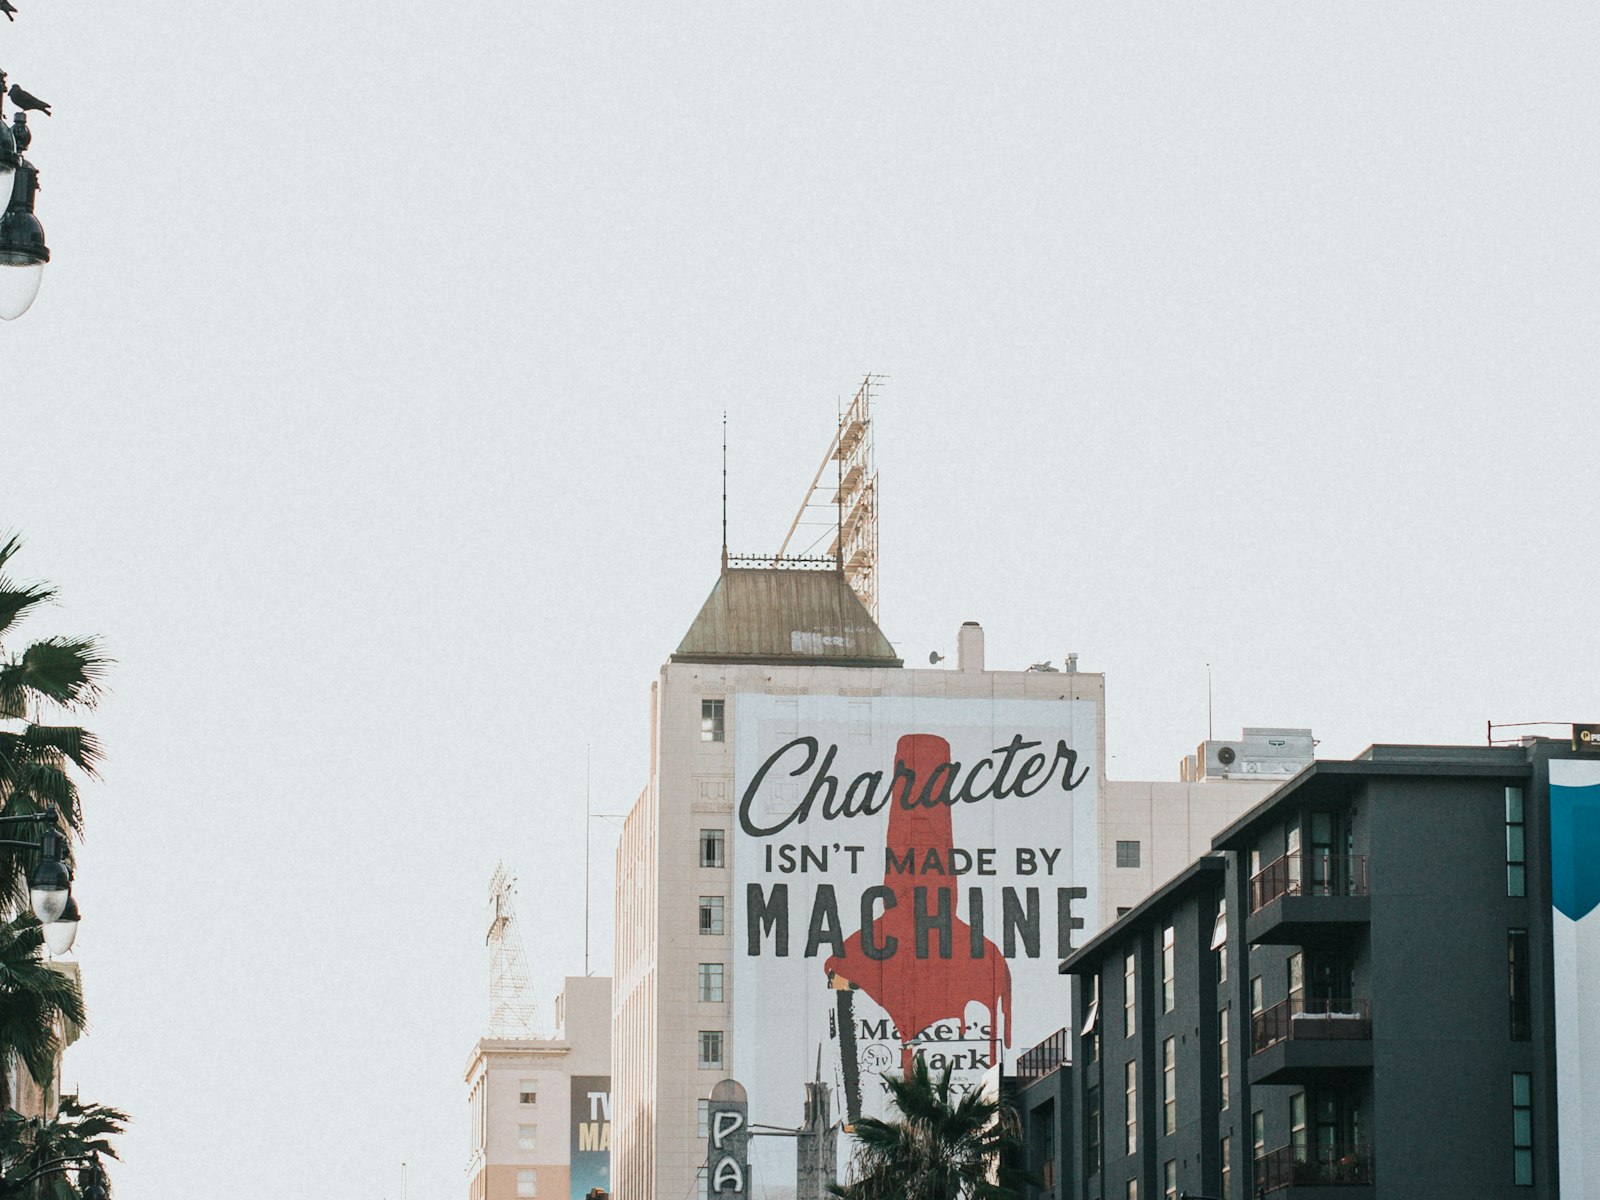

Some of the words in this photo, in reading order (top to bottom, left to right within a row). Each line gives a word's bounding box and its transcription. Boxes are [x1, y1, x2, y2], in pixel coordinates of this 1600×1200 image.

[739, 733, 1090, 837] Character
[765, 844, 864, 875] ISN'T
[885, 847, 996, 876] MADE
[1016, 847, 1062, 876] BY
[747, 883, 1088, 960] MACHINE
